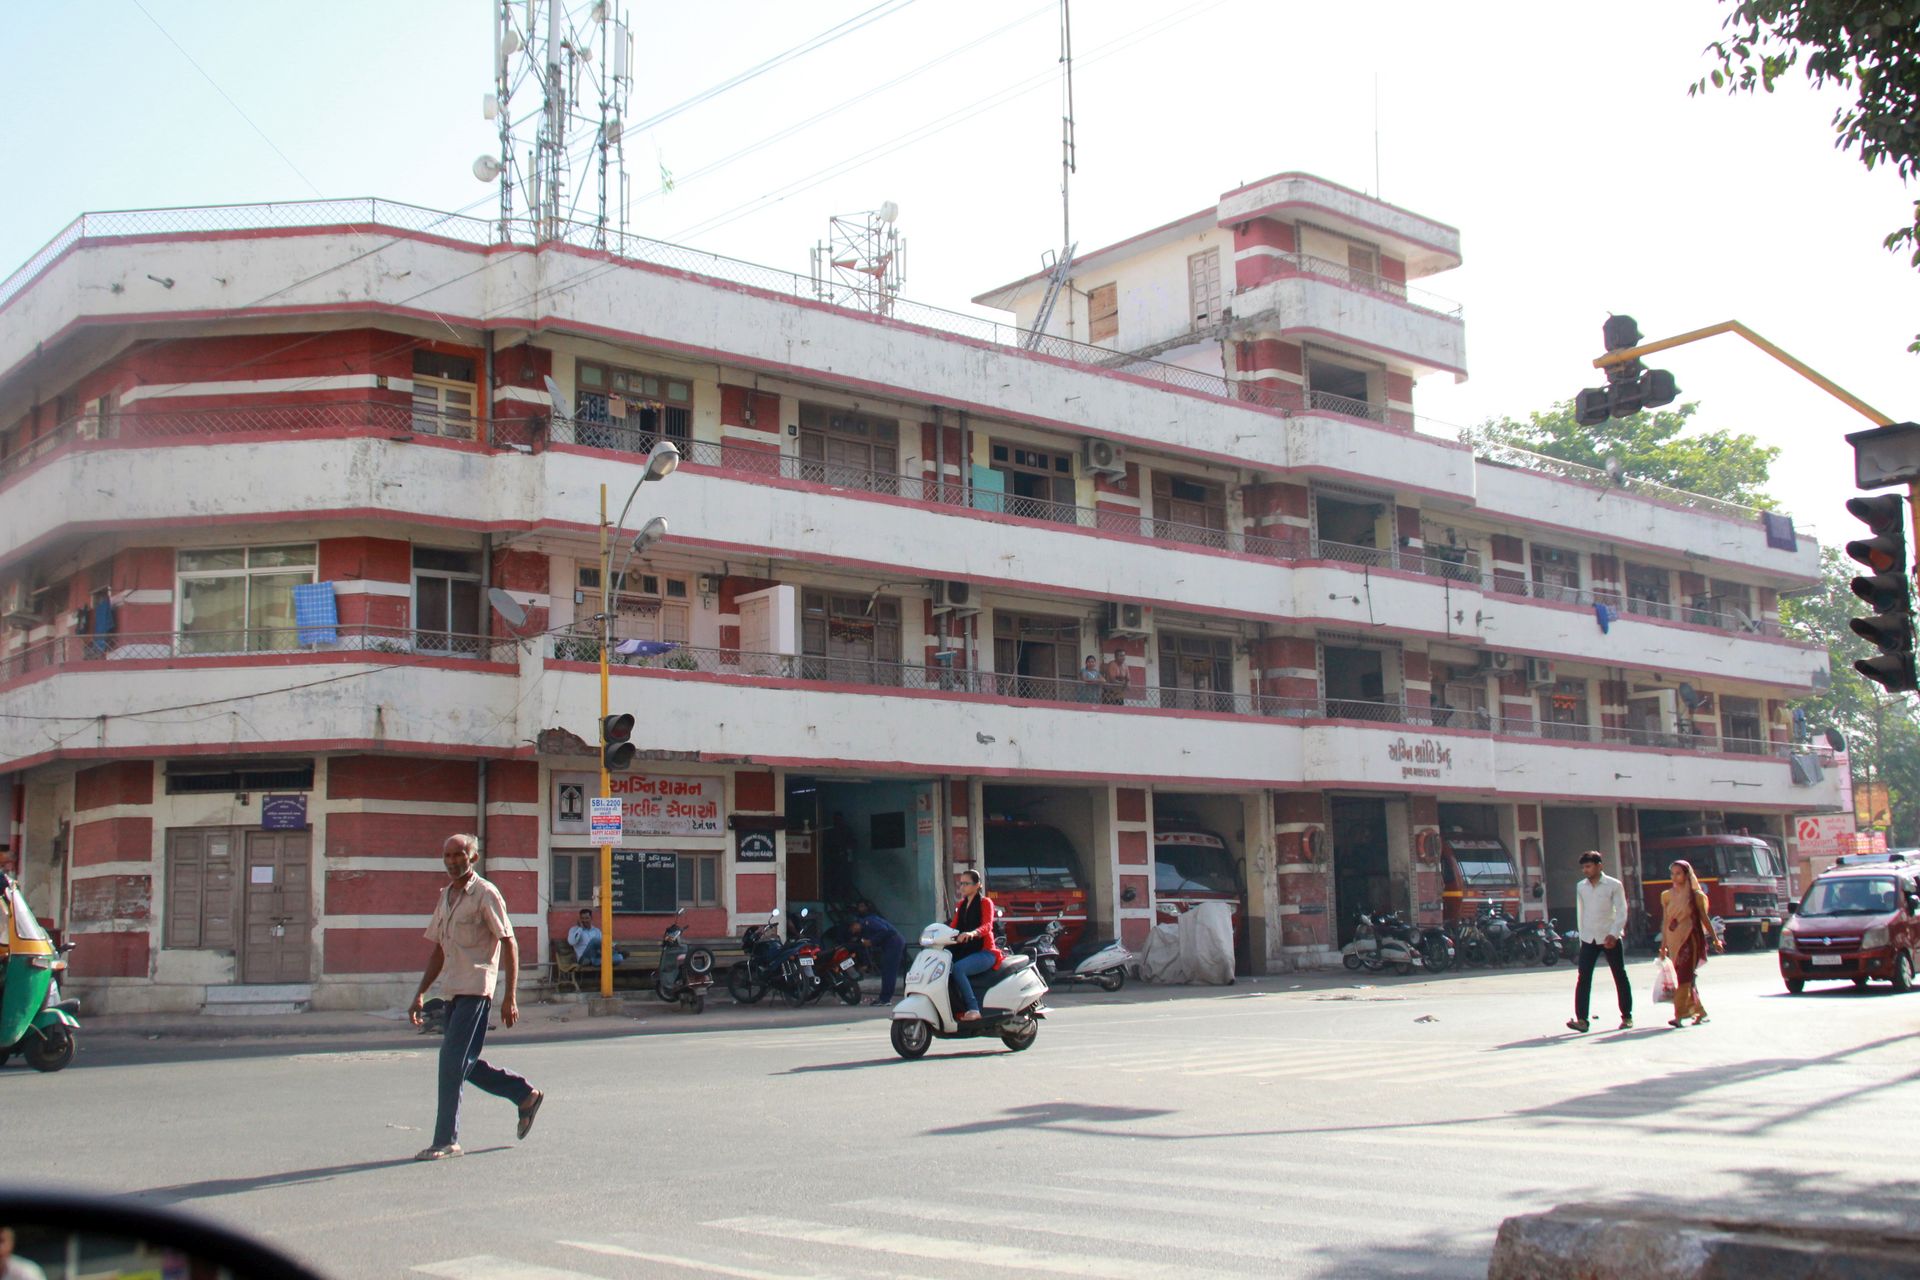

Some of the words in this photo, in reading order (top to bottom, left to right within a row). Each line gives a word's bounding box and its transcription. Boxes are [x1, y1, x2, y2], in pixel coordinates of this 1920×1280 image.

[610, 776, 656, 794] અગ્નિ
[659, 780, 702, 795] શમન
[667, 801, 717, 818] સેવાઓ
